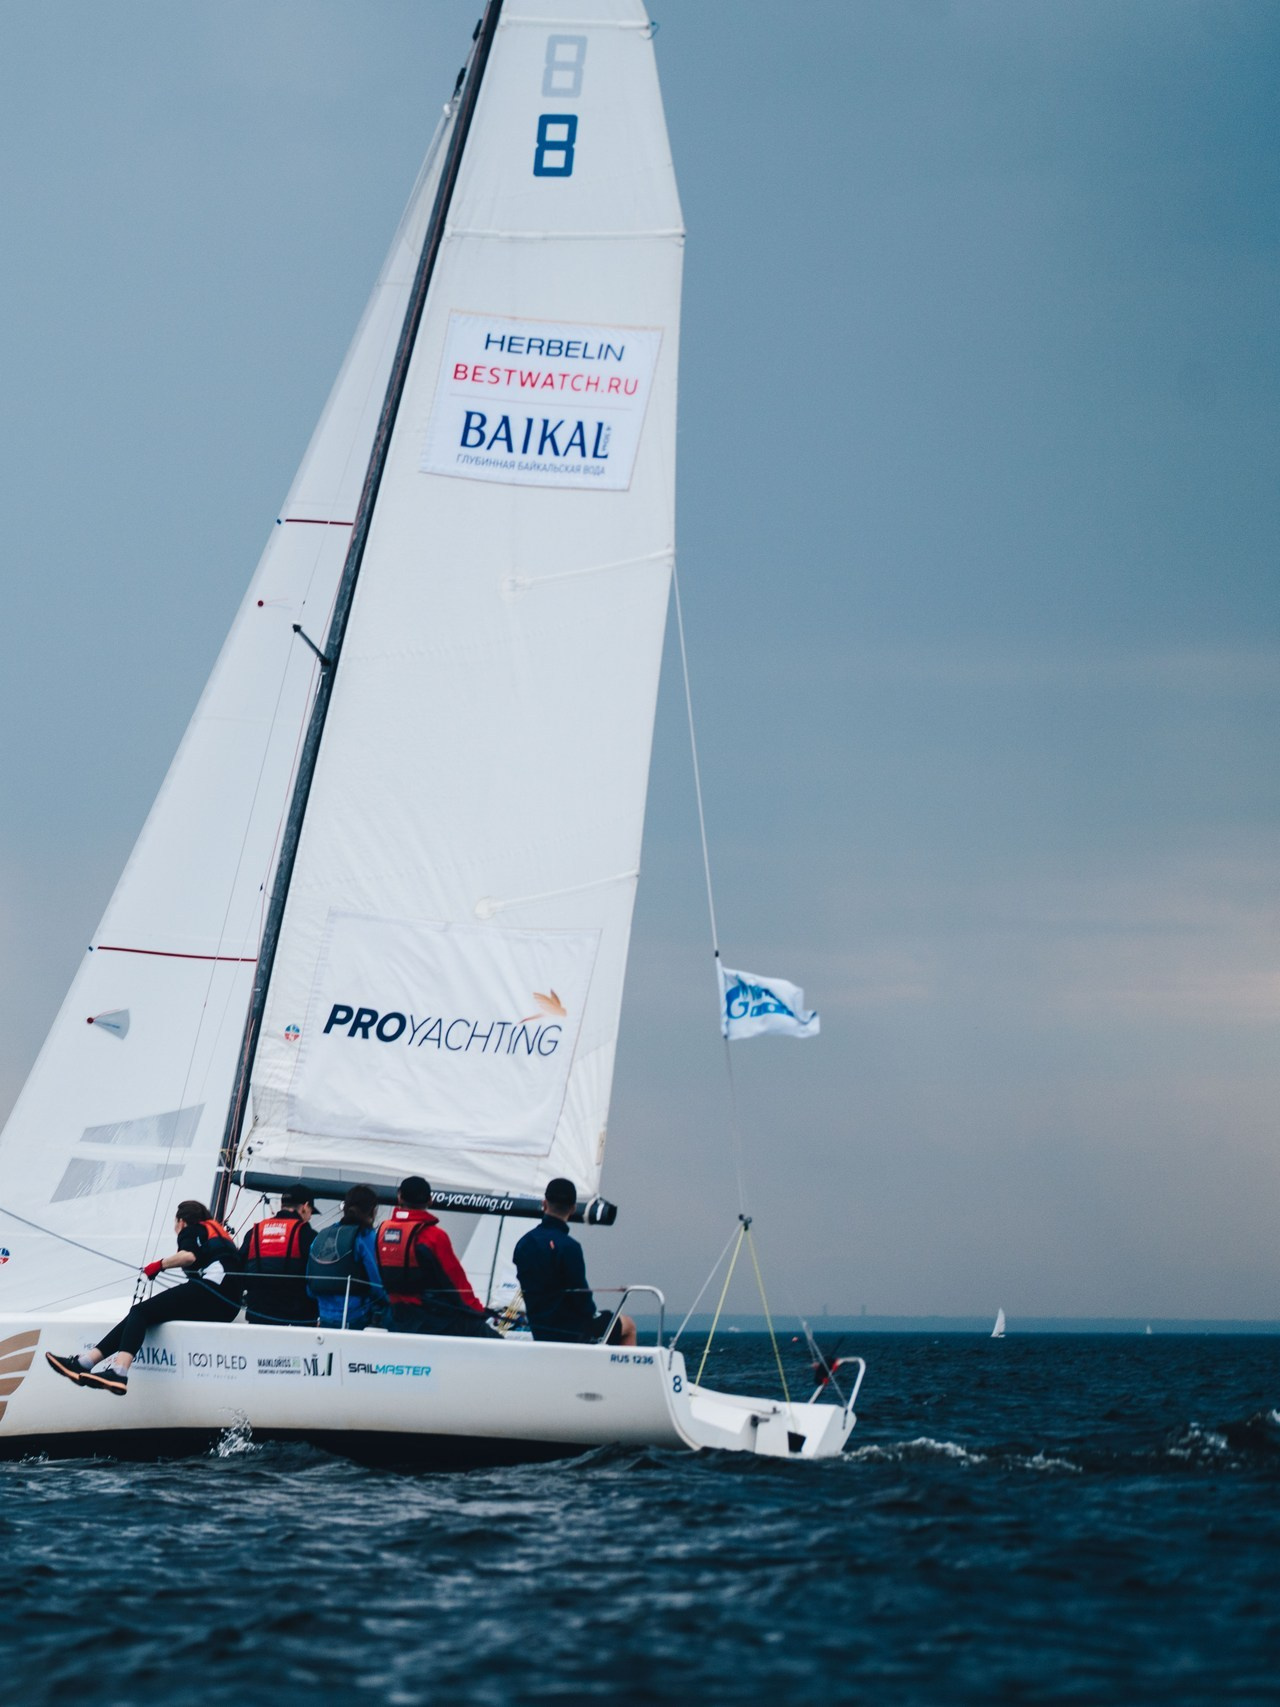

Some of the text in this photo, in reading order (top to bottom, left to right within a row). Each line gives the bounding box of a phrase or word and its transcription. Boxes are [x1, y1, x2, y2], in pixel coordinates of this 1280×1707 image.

[541, 34, 589, 99] 8
[533, 113, 578, 178] 8
[483, 332, 625, 362] HERBELIN
[452, 363, 639, 396] BESTWATCH.RU
[459, 410, 610, 460] BAIKAL
[456, 453, 606, 477] ГЛУБИННАЯ БАЙКАЛЬСКАЯ ВОДА
[322, 1003, 563, 1057] PROYACHTING
[132, 1346, 177, 1367] AIKAL
[216, 1354, 247, 1370] PLED
[348, 1362, 432, 1377] SAILMASTER
[610, 1353, 655, 1365] RUS 1236
[672, 1375, 682, 1393] 8
